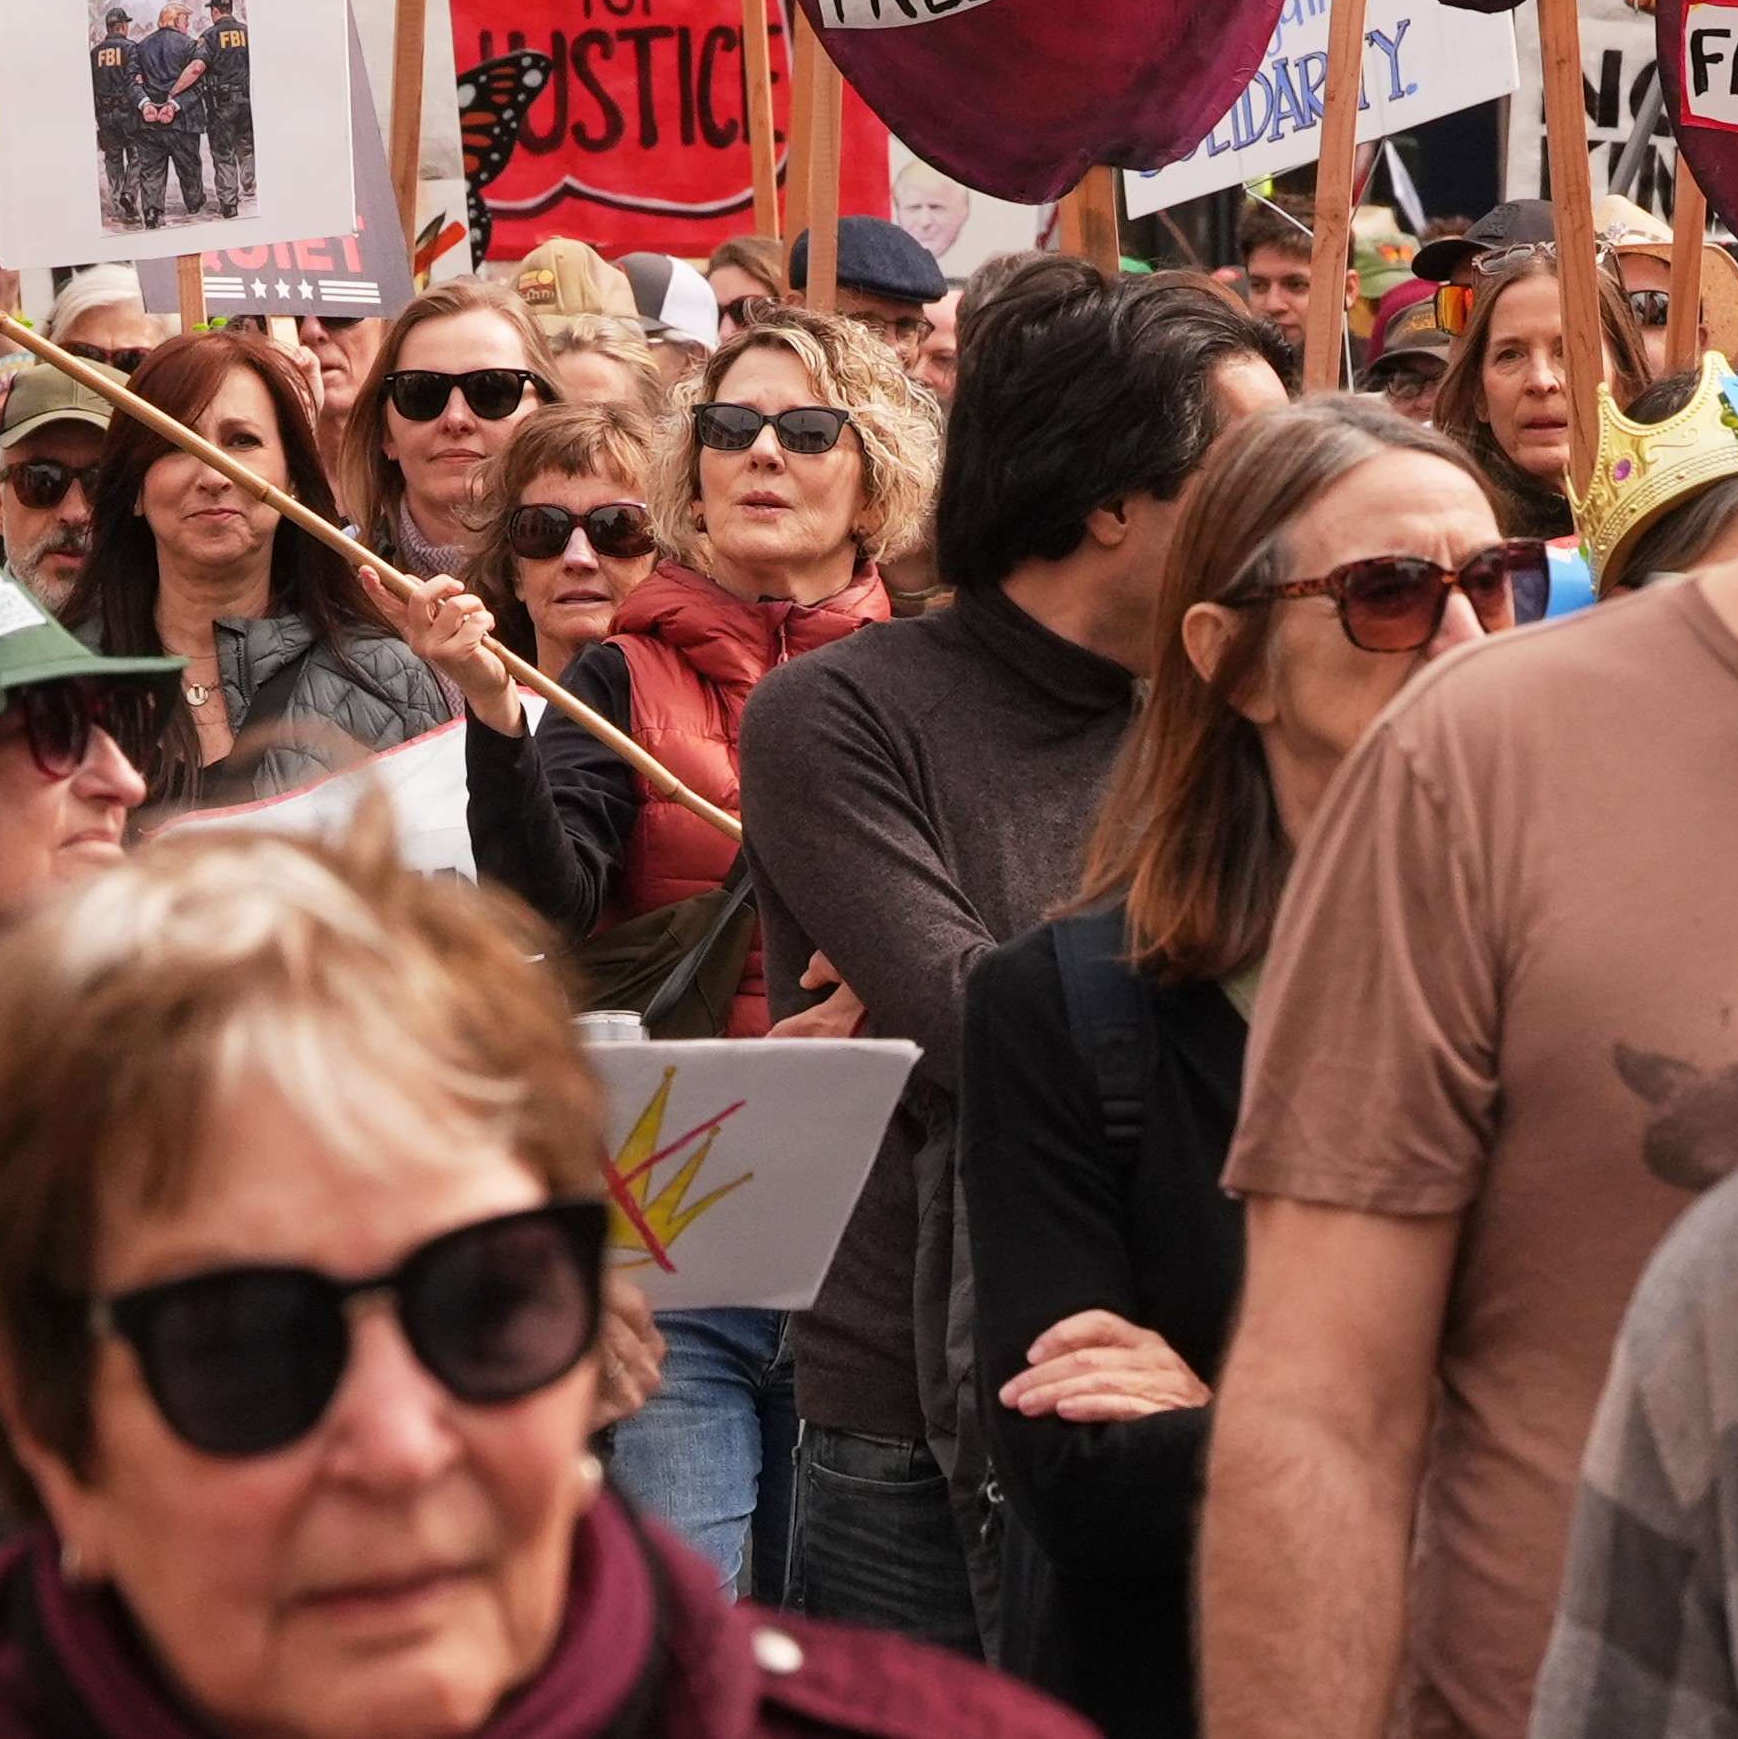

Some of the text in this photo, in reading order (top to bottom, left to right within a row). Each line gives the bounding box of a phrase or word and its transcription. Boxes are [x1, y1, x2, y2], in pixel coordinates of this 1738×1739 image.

[219, 29, 247, 49] FBI
[97, 47, 122, 68] FBI
[479, 25, 785, 157] USTICE
